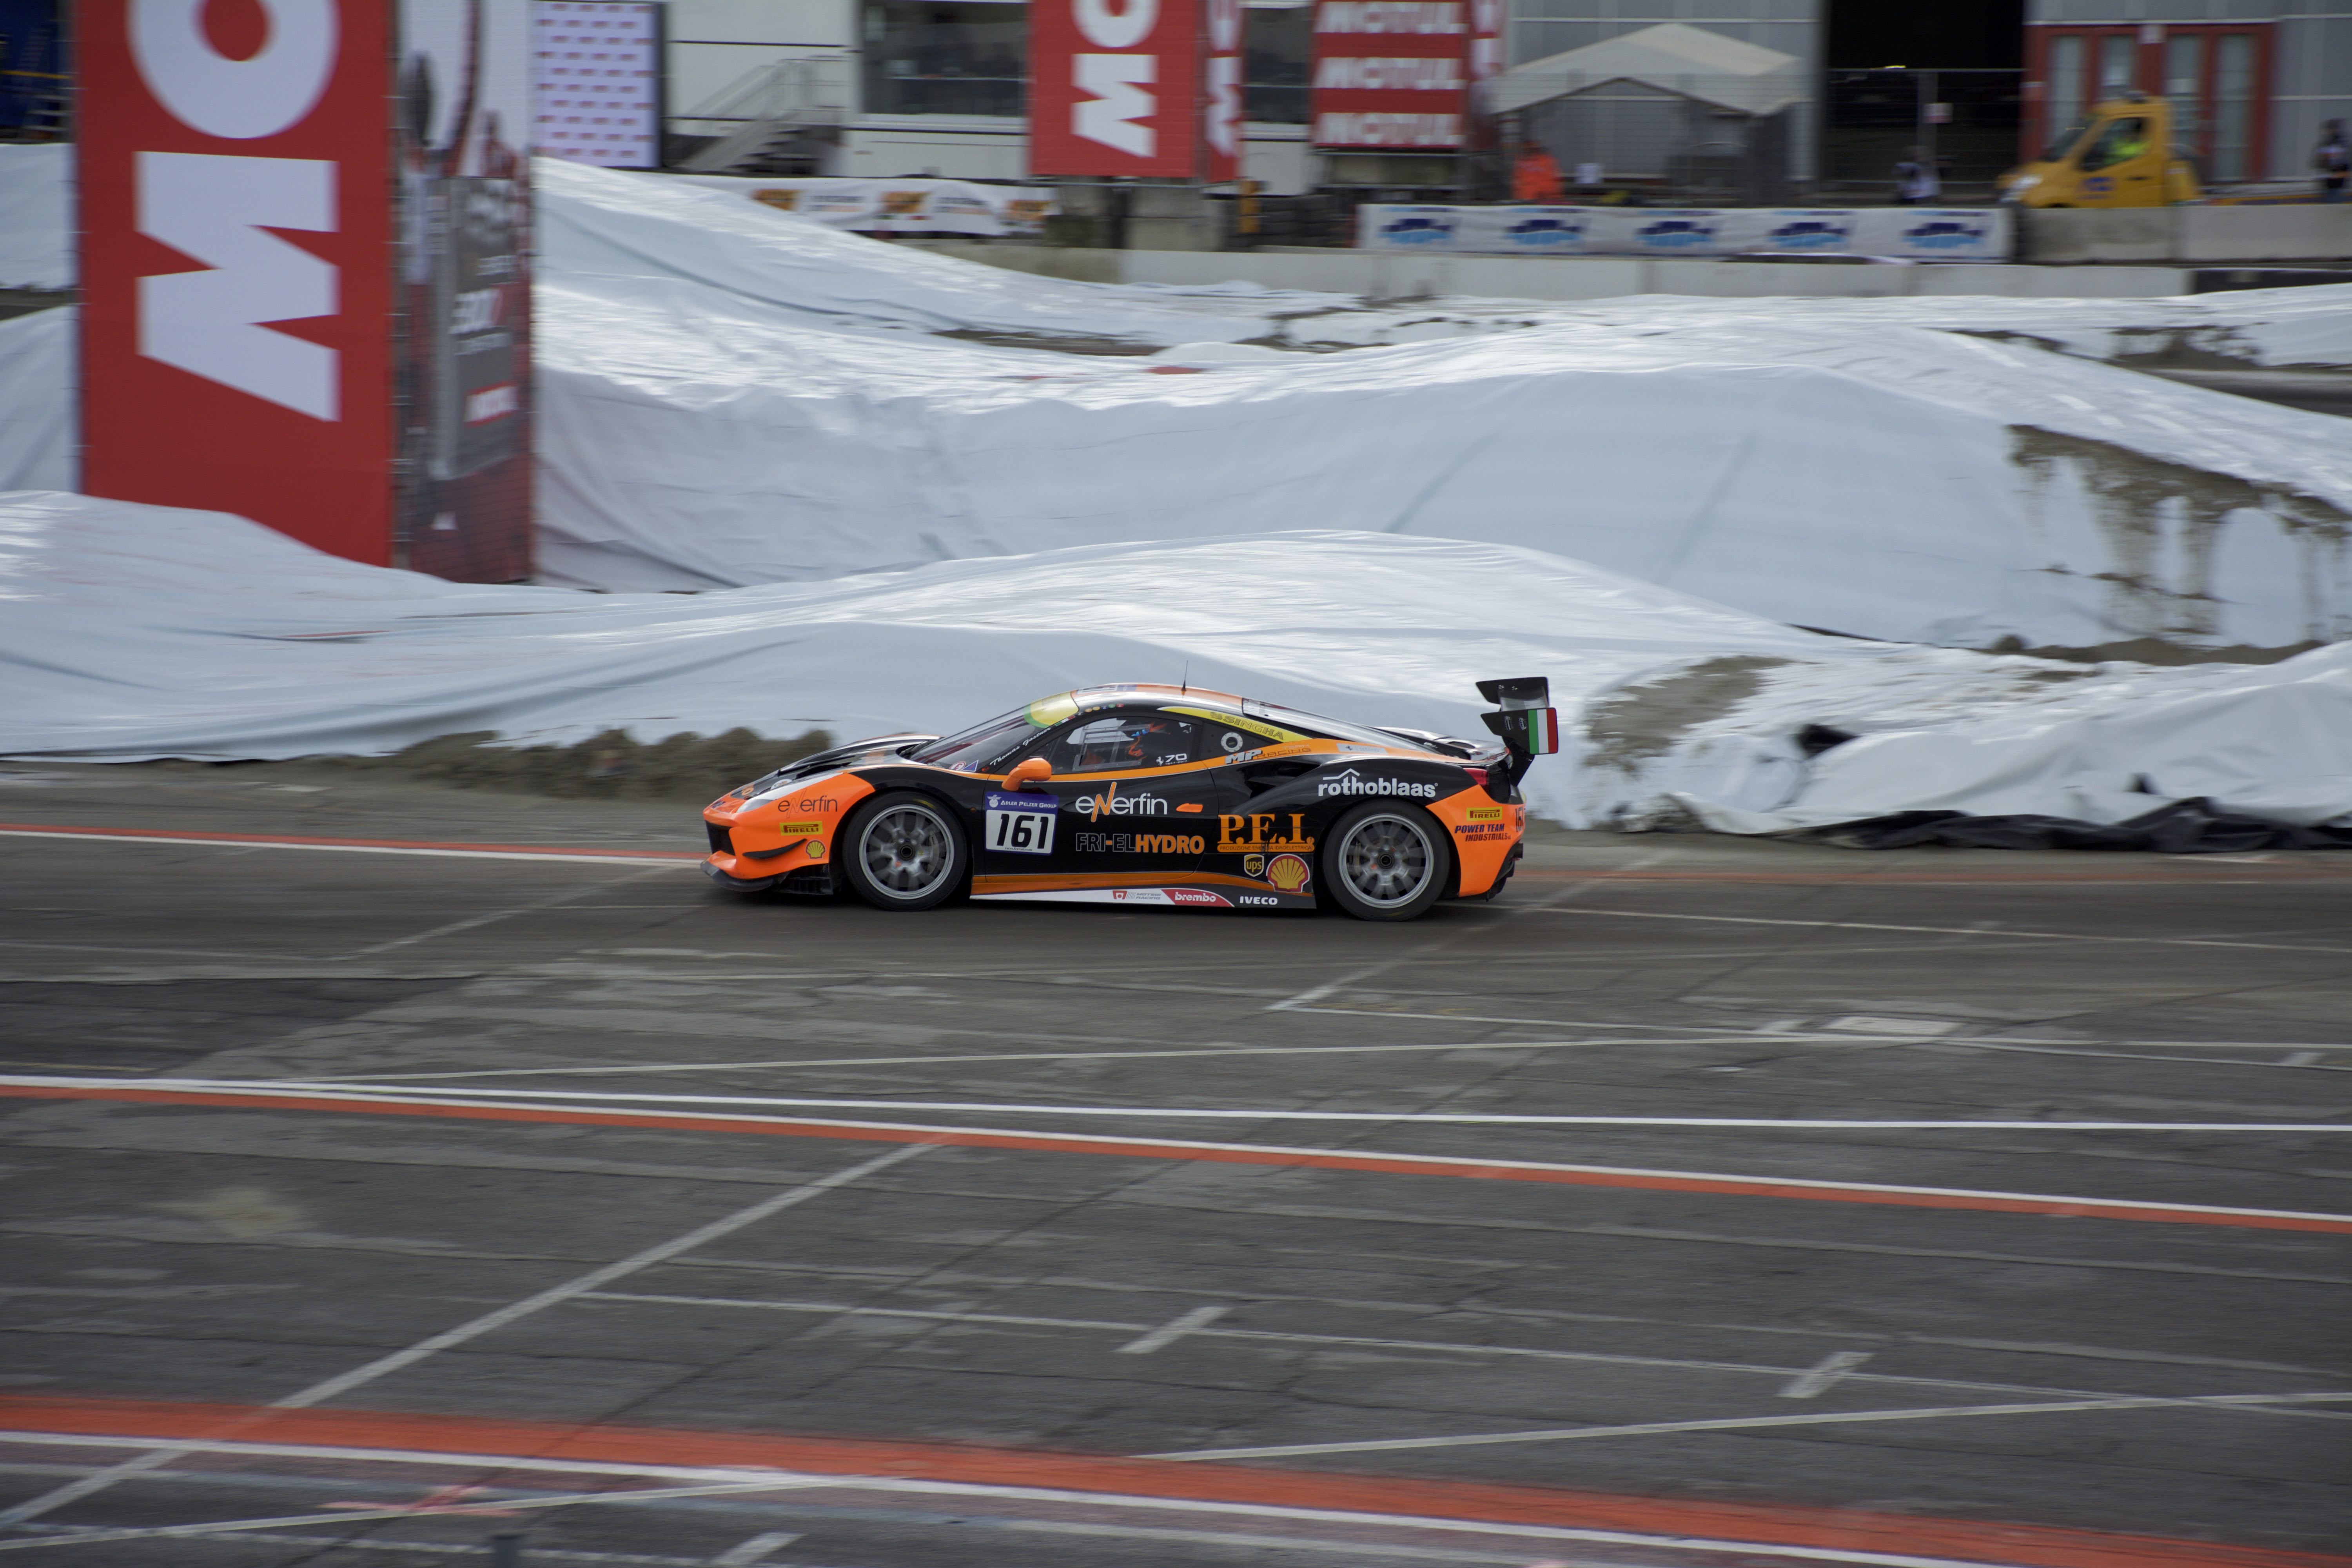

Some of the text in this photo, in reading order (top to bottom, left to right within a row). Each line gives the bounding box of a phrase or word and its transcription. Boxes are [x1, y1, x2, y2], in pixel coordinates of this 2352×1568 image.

[1223, 715, 1284, 740] SINGHA
[989, 746, 1020, 766] Thomas
[1165, 753, 1187, 763] 70
[1225, 748, 1311, 764] MP RACING
[1470, 809, 1501, 818] PIRELLI
[783, 824, 819, 833] PIRELLI
[996, 813, 1049, 849] 161
[1455, 823, 1505, 833] POWER TEAM
[1465, 833, 1508, 842] INDUSTRIALS
[1246, 861, 1262, 873] ups
[1174, 891, 1216, 902] brembo
[1240, 896, 1278, 905] IVECO
